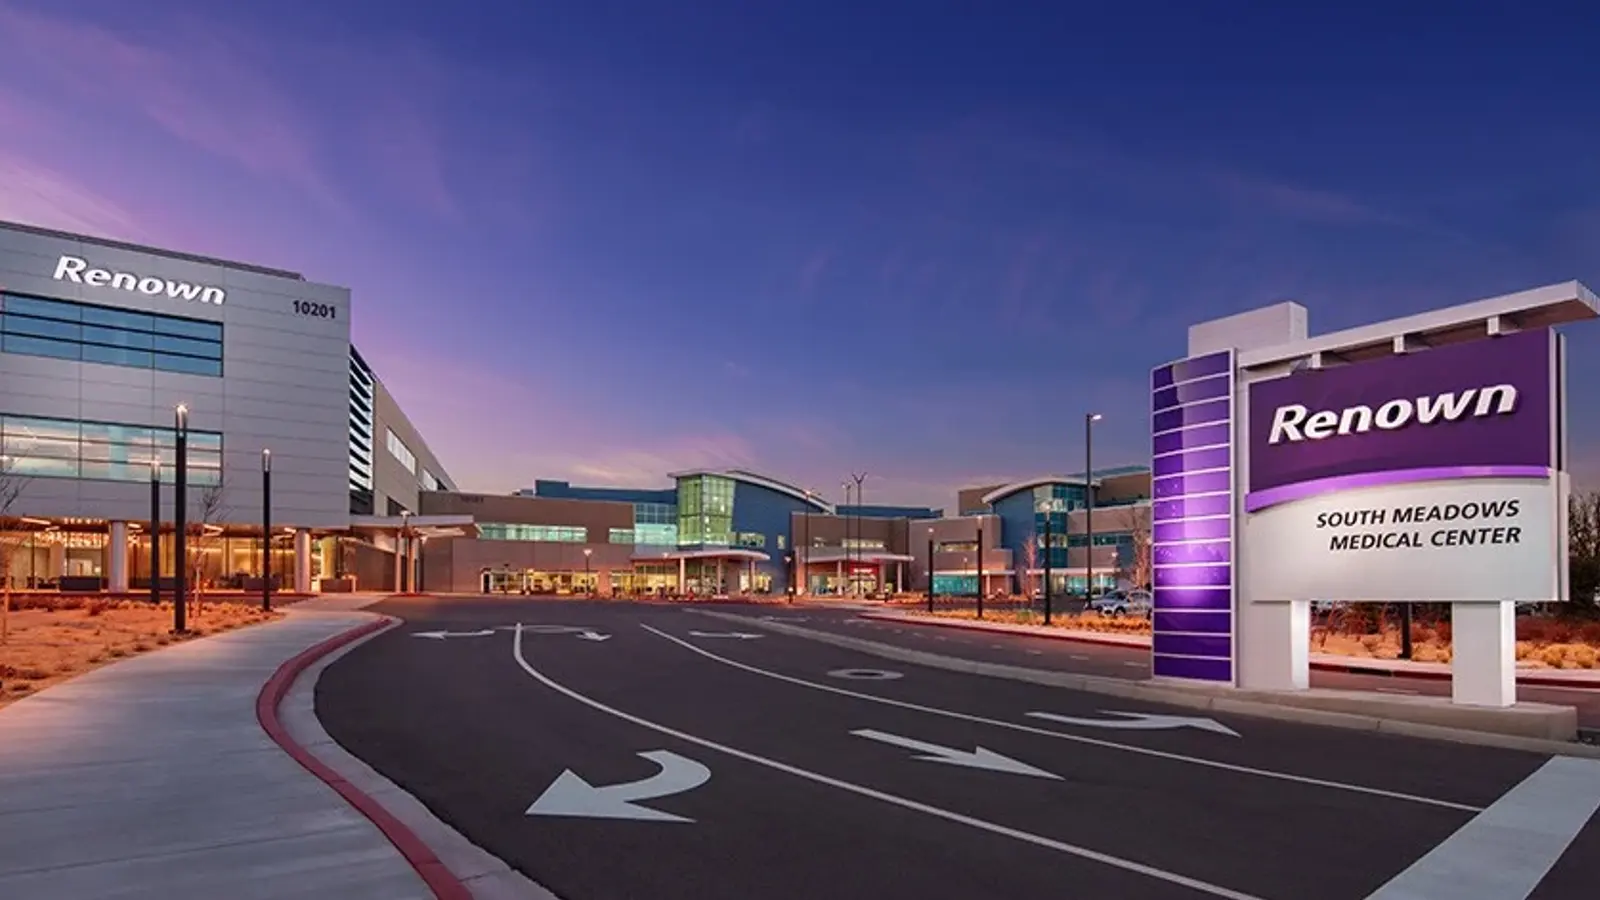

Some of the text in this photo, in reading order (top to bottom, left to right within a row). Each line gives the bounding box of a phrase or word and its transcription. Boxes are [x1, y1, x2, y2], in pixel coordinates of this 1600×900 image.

[53, 255, 226, 305] Renown
[292, 299, 336, 320] 10201
[1267, 383, 1517, 444] Renown
[1316, 500, 1520, 528] SOUTH MEADOWS
[1329, 527, 1521, 551] MEDICAL CENTER
